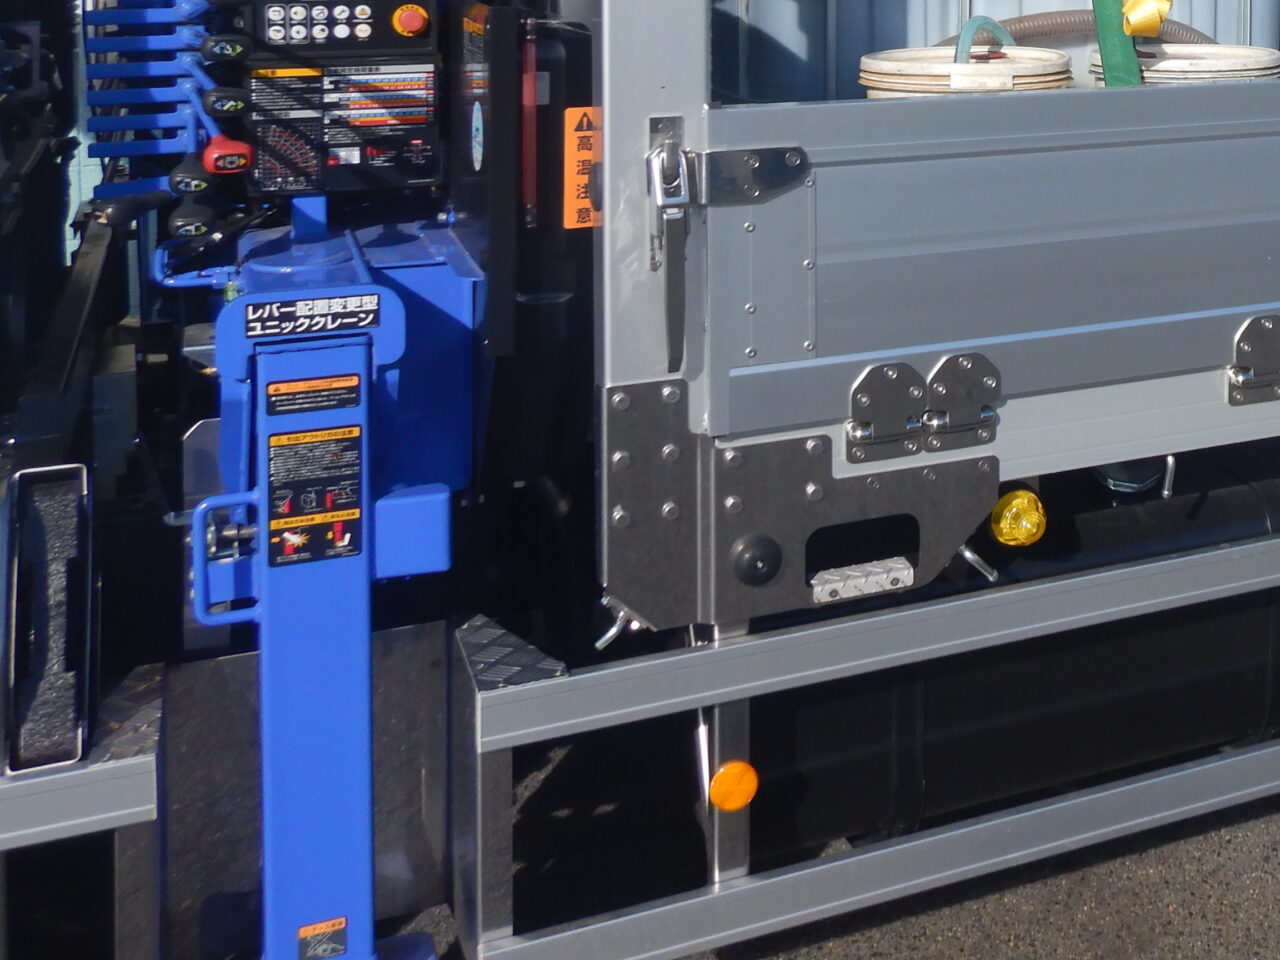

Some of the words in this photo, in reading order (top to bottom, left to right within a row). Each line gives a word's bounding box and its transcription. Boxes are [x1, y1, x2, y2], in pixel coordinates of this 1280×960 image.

[576, 135, 593, 224] 高温注意
[247, 294, 379, 320] レバー配置変更型
[247, 313, 375, 336] ユニッククレーン
